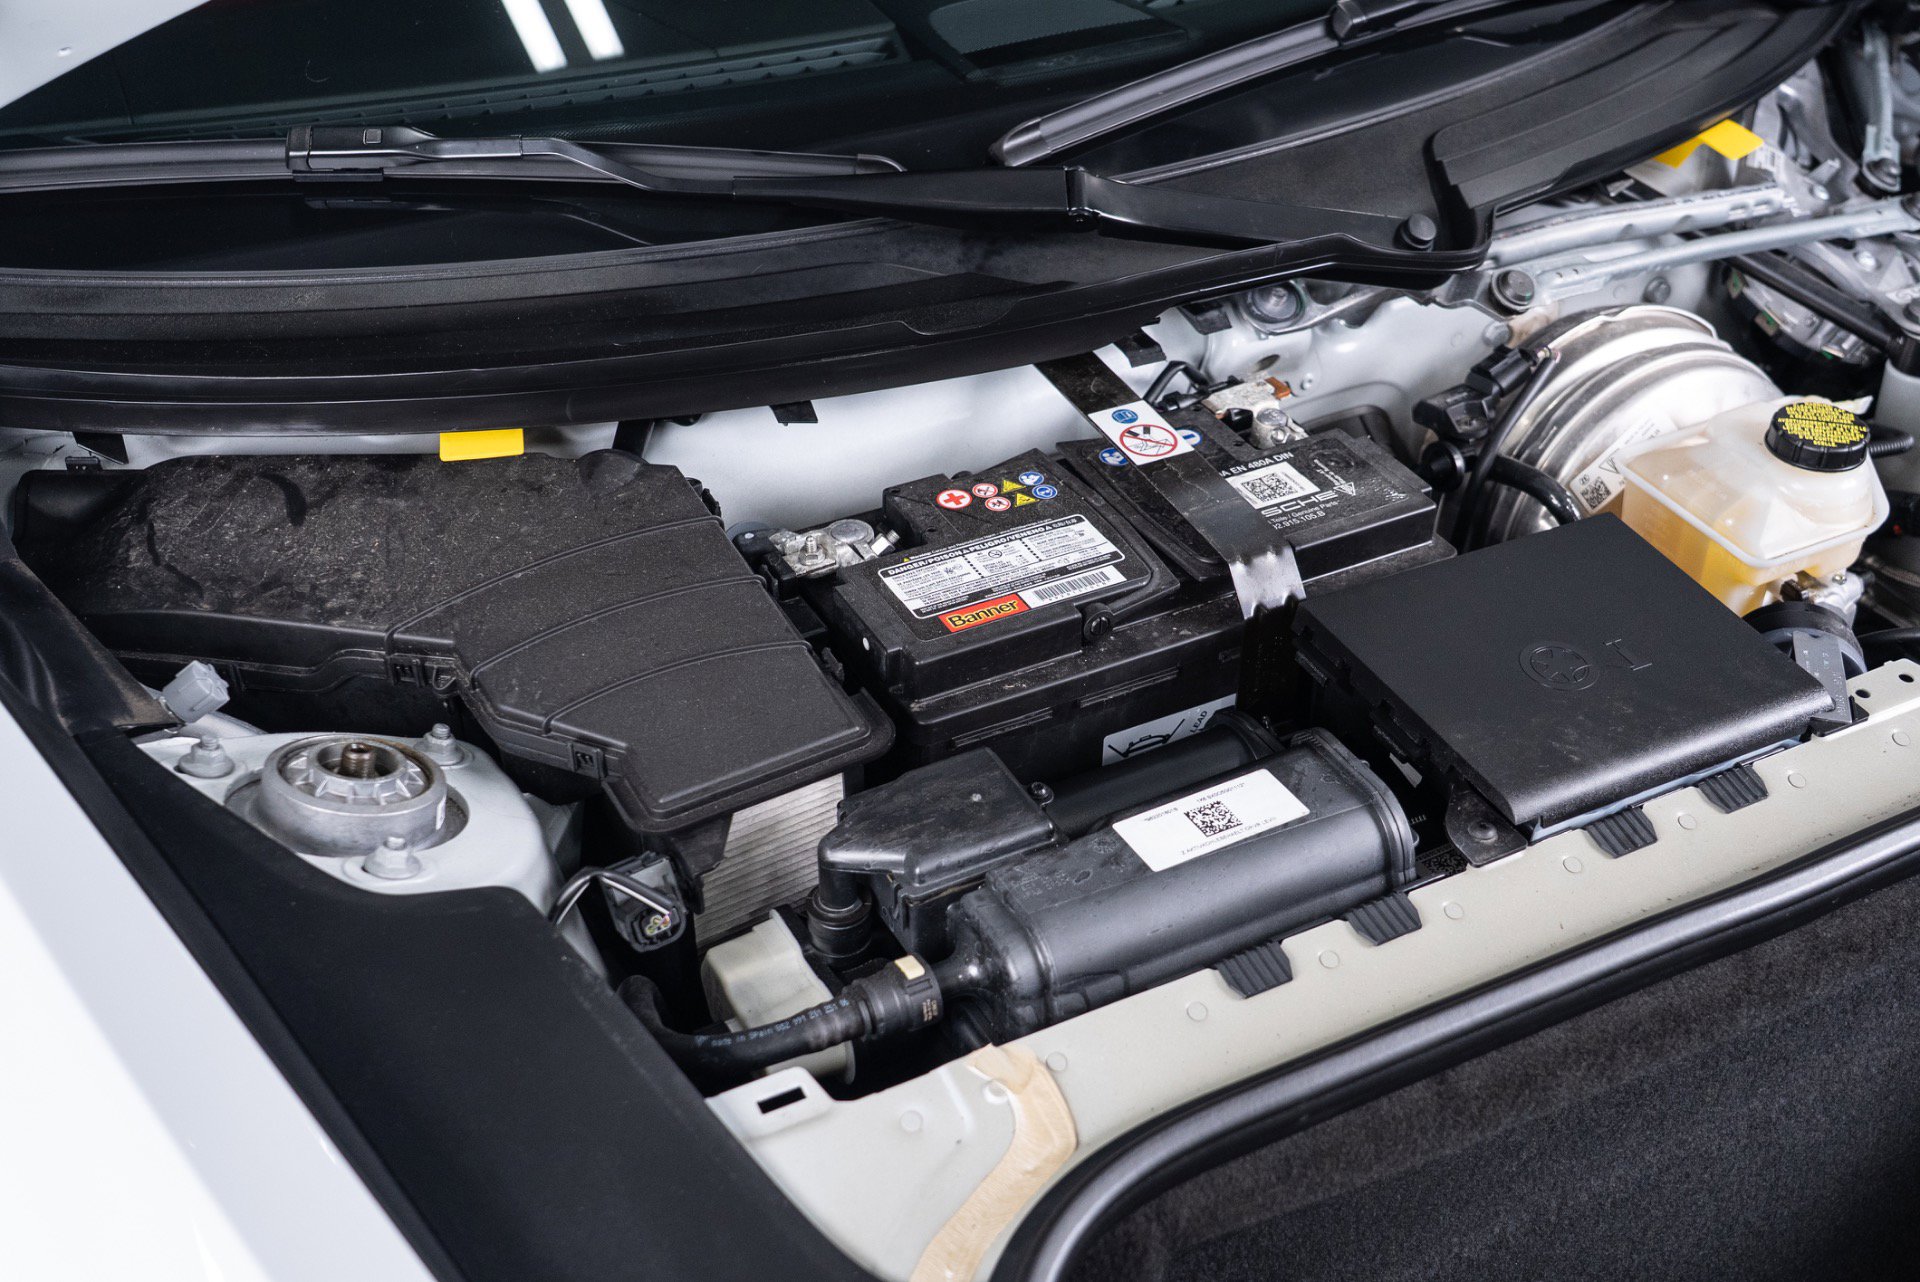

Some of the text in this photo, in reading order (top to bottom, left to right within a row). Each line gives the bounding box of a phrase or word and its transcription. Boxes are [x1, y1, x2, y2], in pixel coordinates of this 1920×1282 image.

[1230, 465, 1247, 474] EN
[1272, 451, 1294, 462] DIN
[1261, 490, 1339, 517] SCHE
[888, 551, 963, 576] DANGER/POISON
[947, 601, 1017, 627] Banner
[1190, 710, 1208, 733] LEAD
